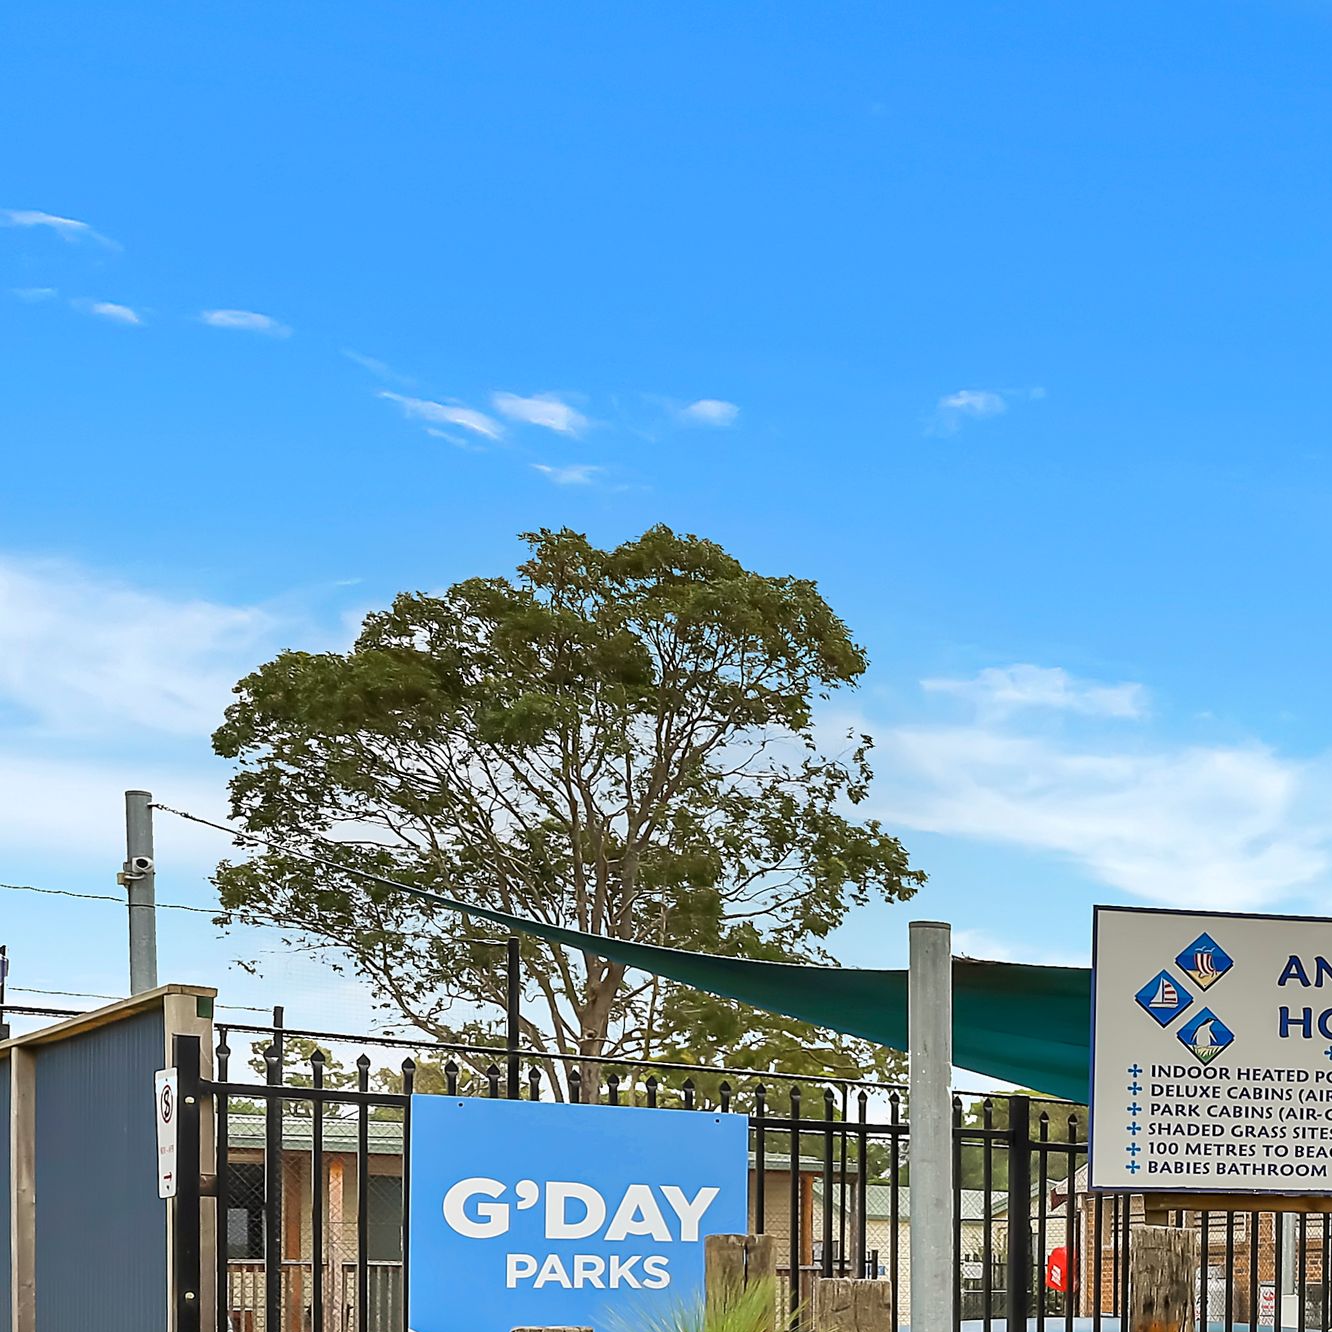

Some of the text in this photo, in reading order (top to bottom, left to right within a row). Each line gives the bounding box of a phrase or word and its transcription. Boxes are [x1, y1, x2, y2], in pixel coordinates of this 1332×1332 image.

[1151, 1065, 1231, 1080] INDOOR
[1237, 1068, 1309, 1083] HEATED
[1151, 1084, 1221, 1098] DELUXE
[1227, 1086, 1293, 1101] CABINS
[1150, 1103, 1200, 1117] PARK
[1207, 1105, 1273, 1119] CABINS
[1148, 1122, 1224, 1137] SHADED
[1231, 1125, 1287, 1139] GRASS
[1148, 1142, 1178, 1155] 100
[1185, 1143, 1256, 1157] METRES
[1263, 1144, 1289, 1158] TO
[1148, 1161, 1327, 1177] BABIES BATHROOM
[442, 1177, 721, 1242] G'DAY
[506, 1253, 671, 1289] PARKS
